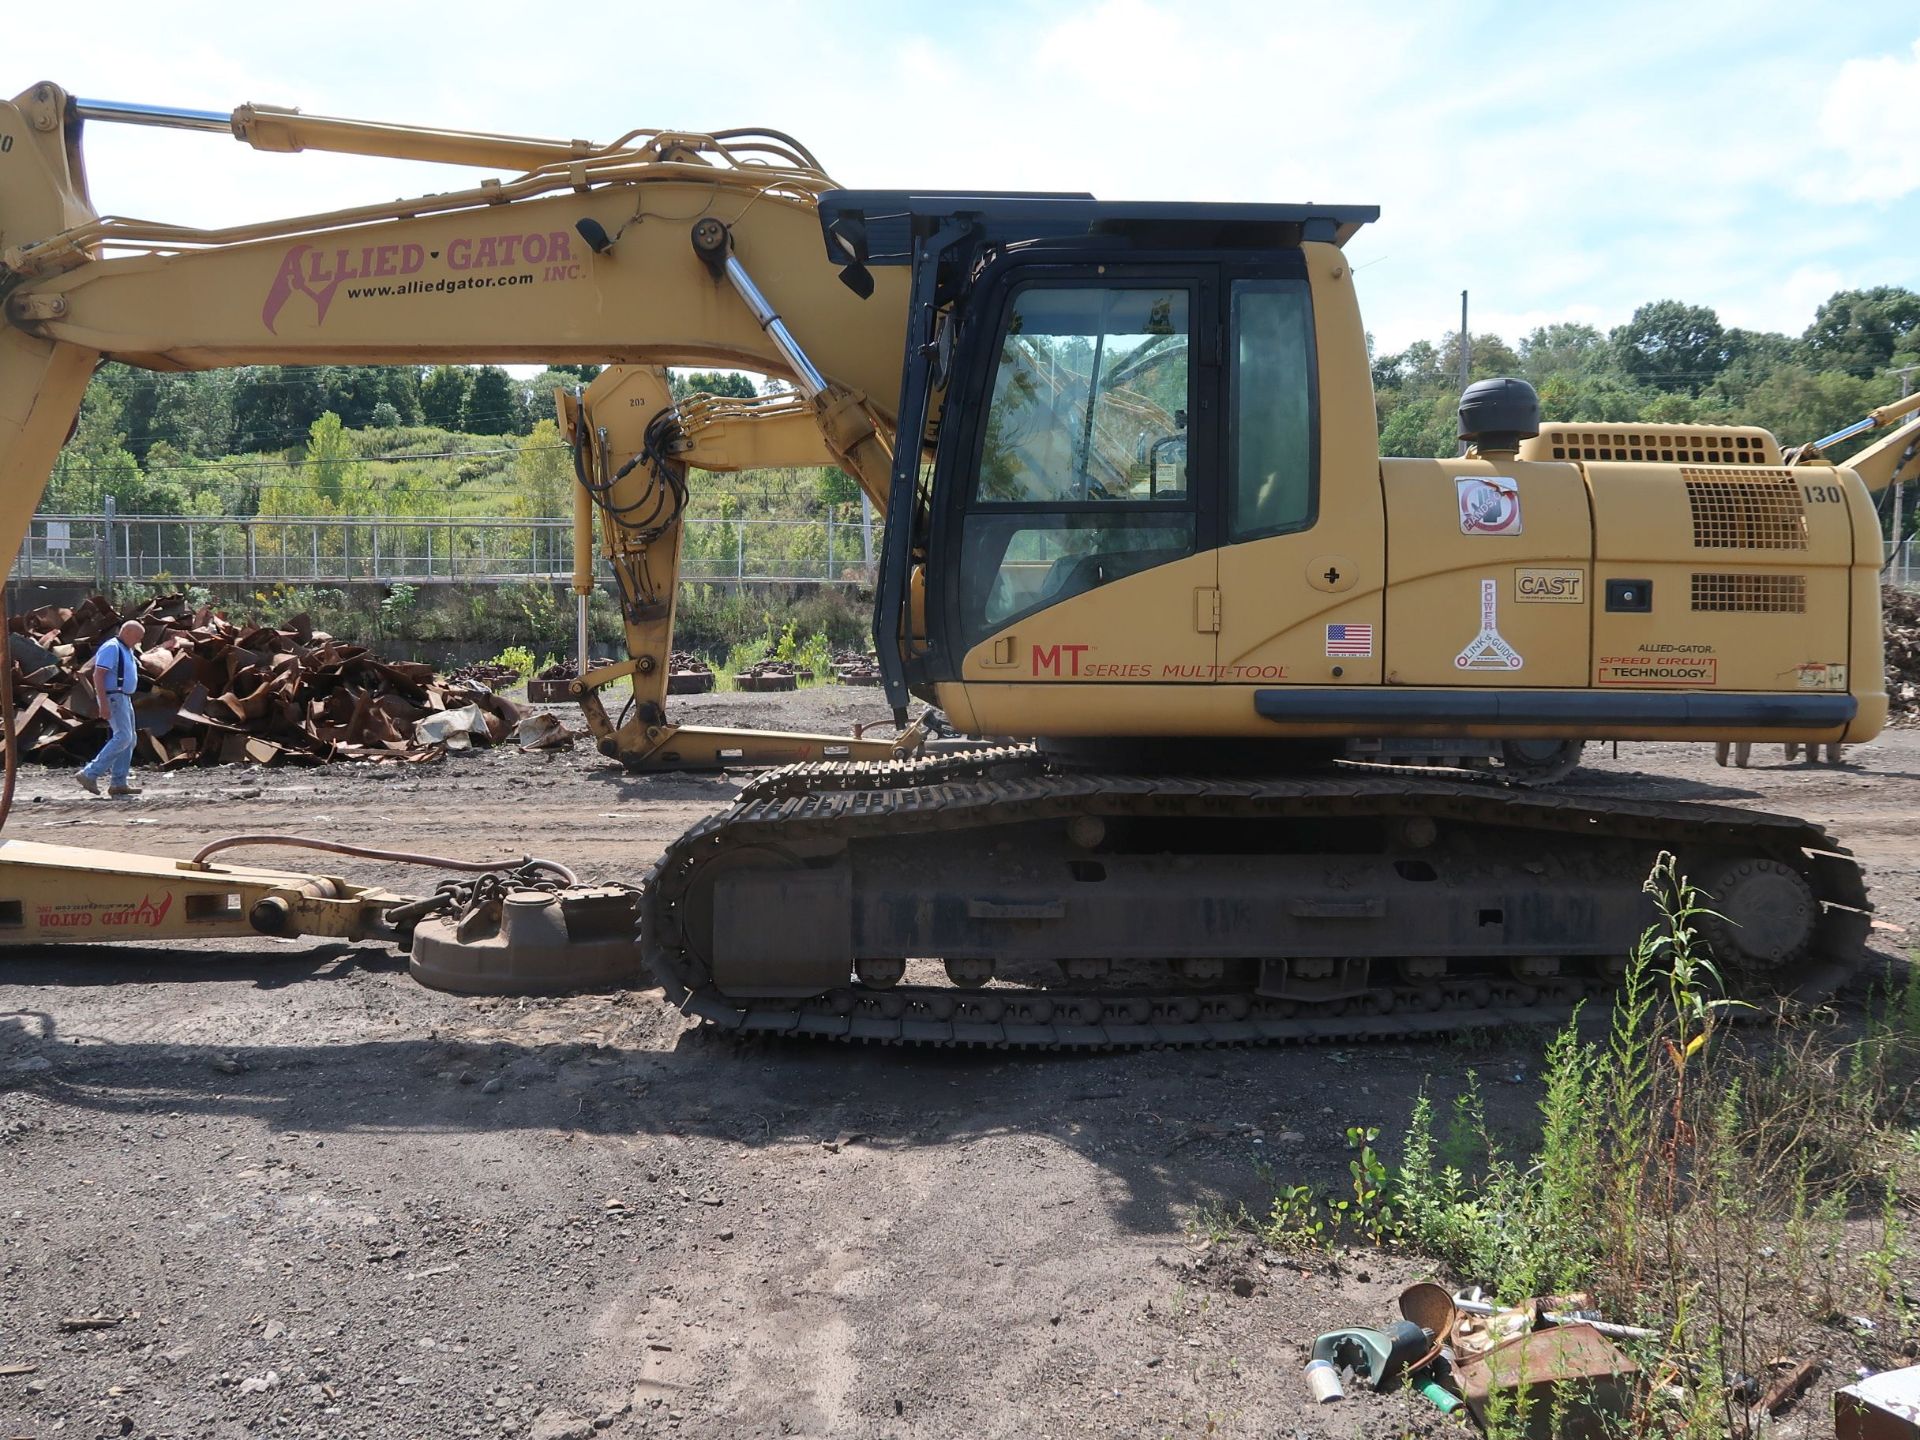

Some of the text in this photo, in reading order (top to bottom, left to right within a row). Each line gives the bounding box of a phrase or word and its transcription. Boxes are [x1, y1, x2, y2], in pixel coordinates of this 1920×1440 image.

[0, 135, 13, 153] 0
[447, 232, 571, 271] GATOR
[347, 273, 533, 299] www.alliedgator.com
[629, 398, 645, 407] 203
[1804, 485, 1841, 504] 130
[1519, 576, 1580, 595] CAST
[1484, 583, 1494, 630] POWER
[1463, 637, 1486, 660] LINK
[1491, 638, 1515, 661] GUIDE
[1638, 644, 1713, 653] ALLIED-GATOR
[1032, 645, 1289, 678] MT SERIES MULTI-TOOL
[1600, 656, 1716, 666] SPEED CIRCUIT
[1612, 667, 1707, 678] TECHNOLOGY
[40, 912, 93, 927] GATOR
